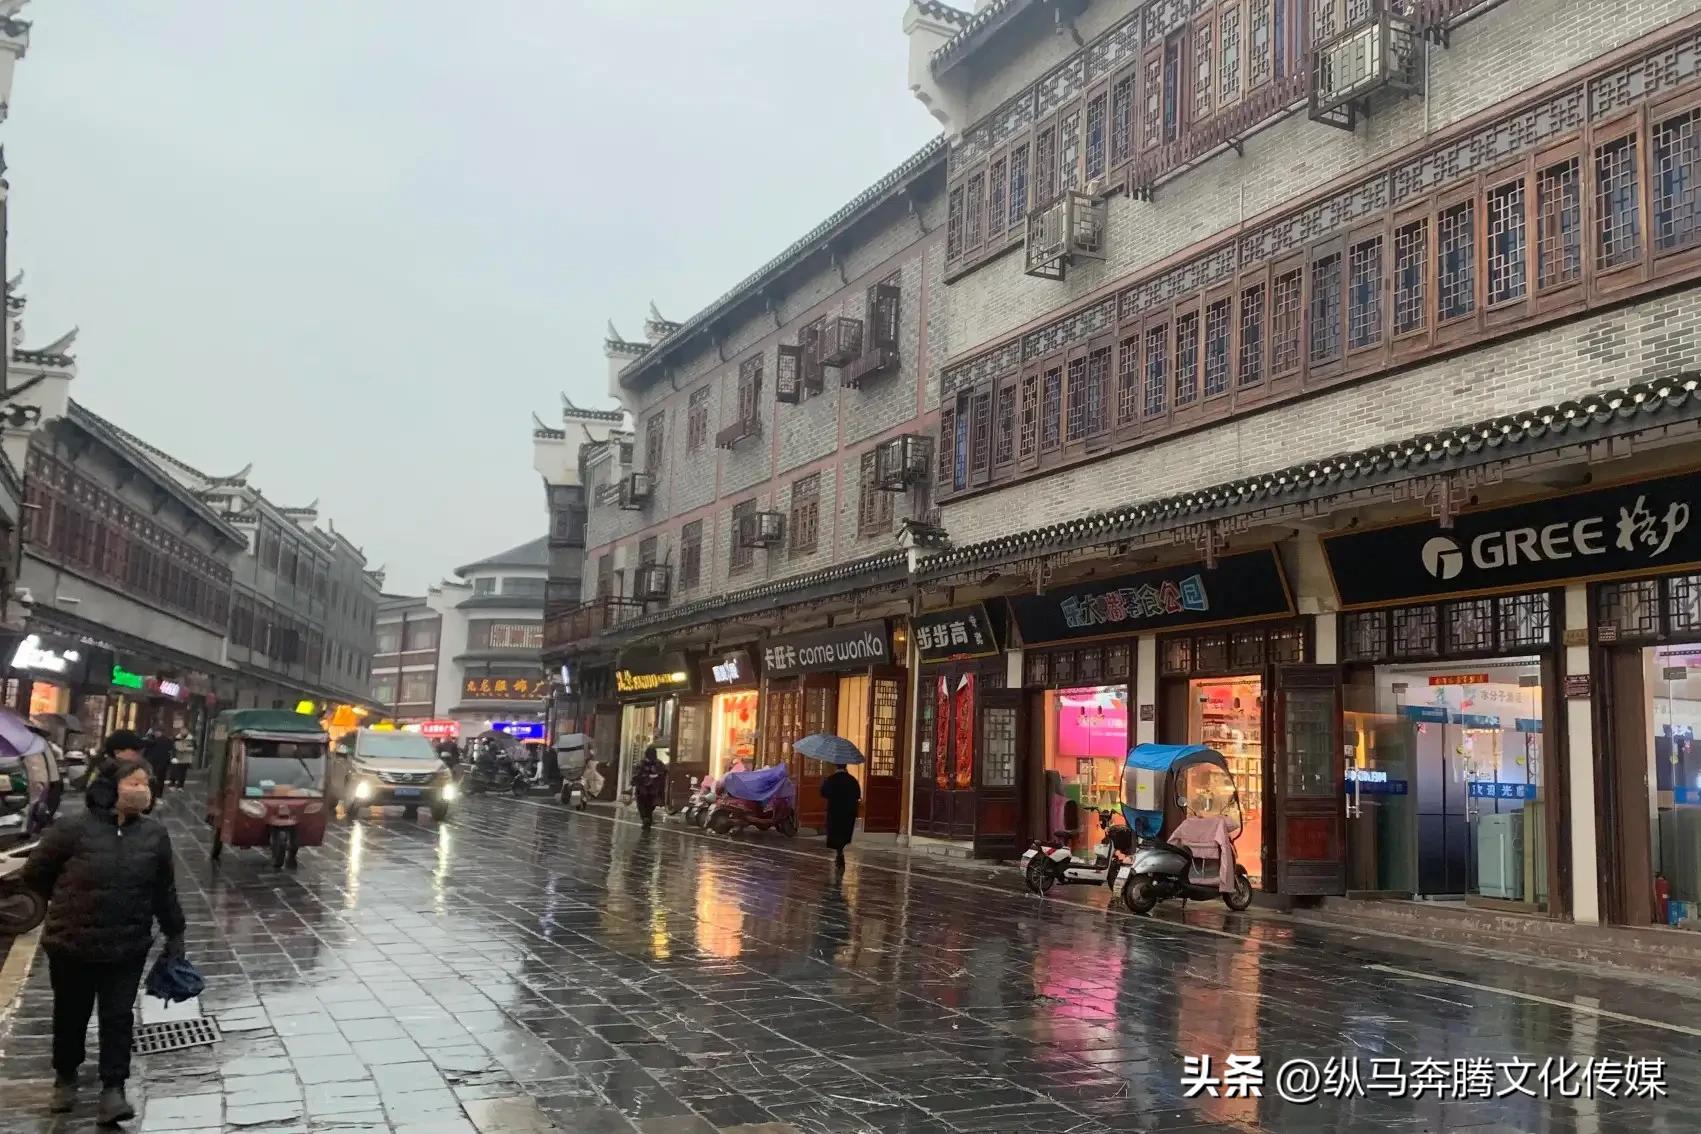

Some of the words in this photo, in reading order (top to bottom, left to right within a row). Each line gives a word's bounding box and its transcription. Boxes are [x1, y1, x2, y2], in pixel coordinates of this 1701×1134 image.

[1470, 516, 1607, 570] GREE
[1615, 494, 1690, 559] 格力
[916, 620, 970, 650] 步步高
[763, 644, 797, 671] 卡旺卡
[799, 643, 835, 666] come
